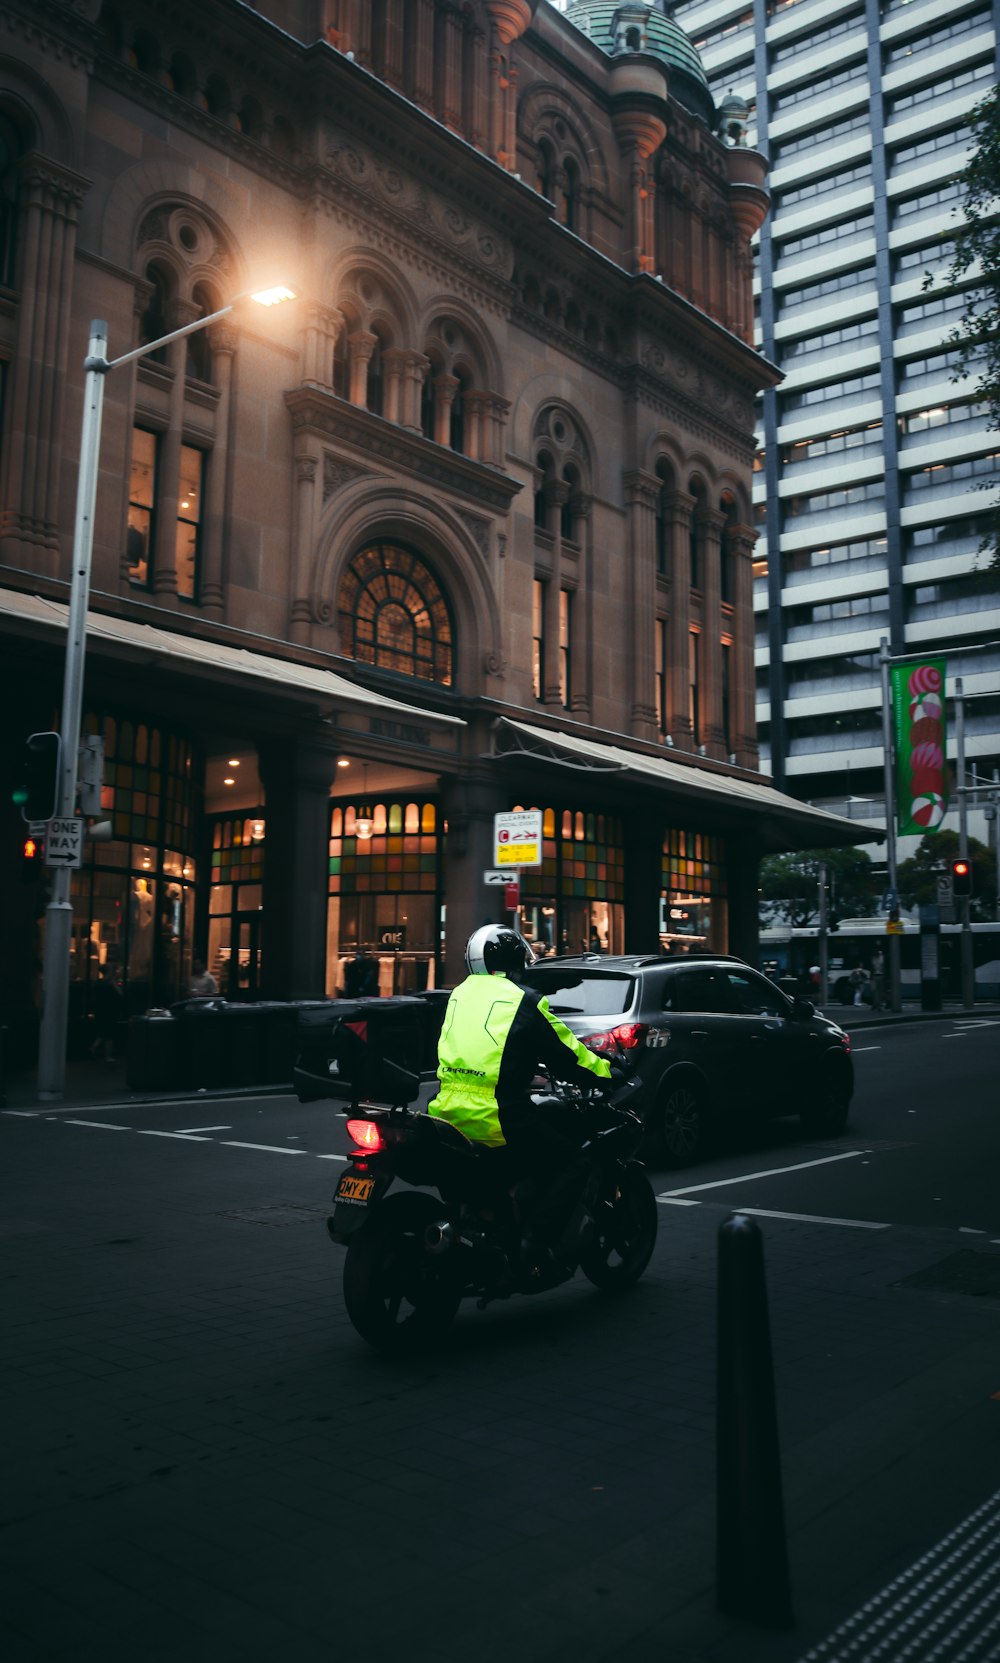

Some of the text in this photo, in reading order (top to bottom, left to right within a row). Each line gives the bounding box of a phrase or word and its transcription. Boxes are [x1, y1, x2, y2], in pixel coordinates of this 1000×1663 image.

[500, 814, 535, 822] CLEARWAY
[51, 821, 78, 834] ONE
[49, 837, 79, 849] WAY
